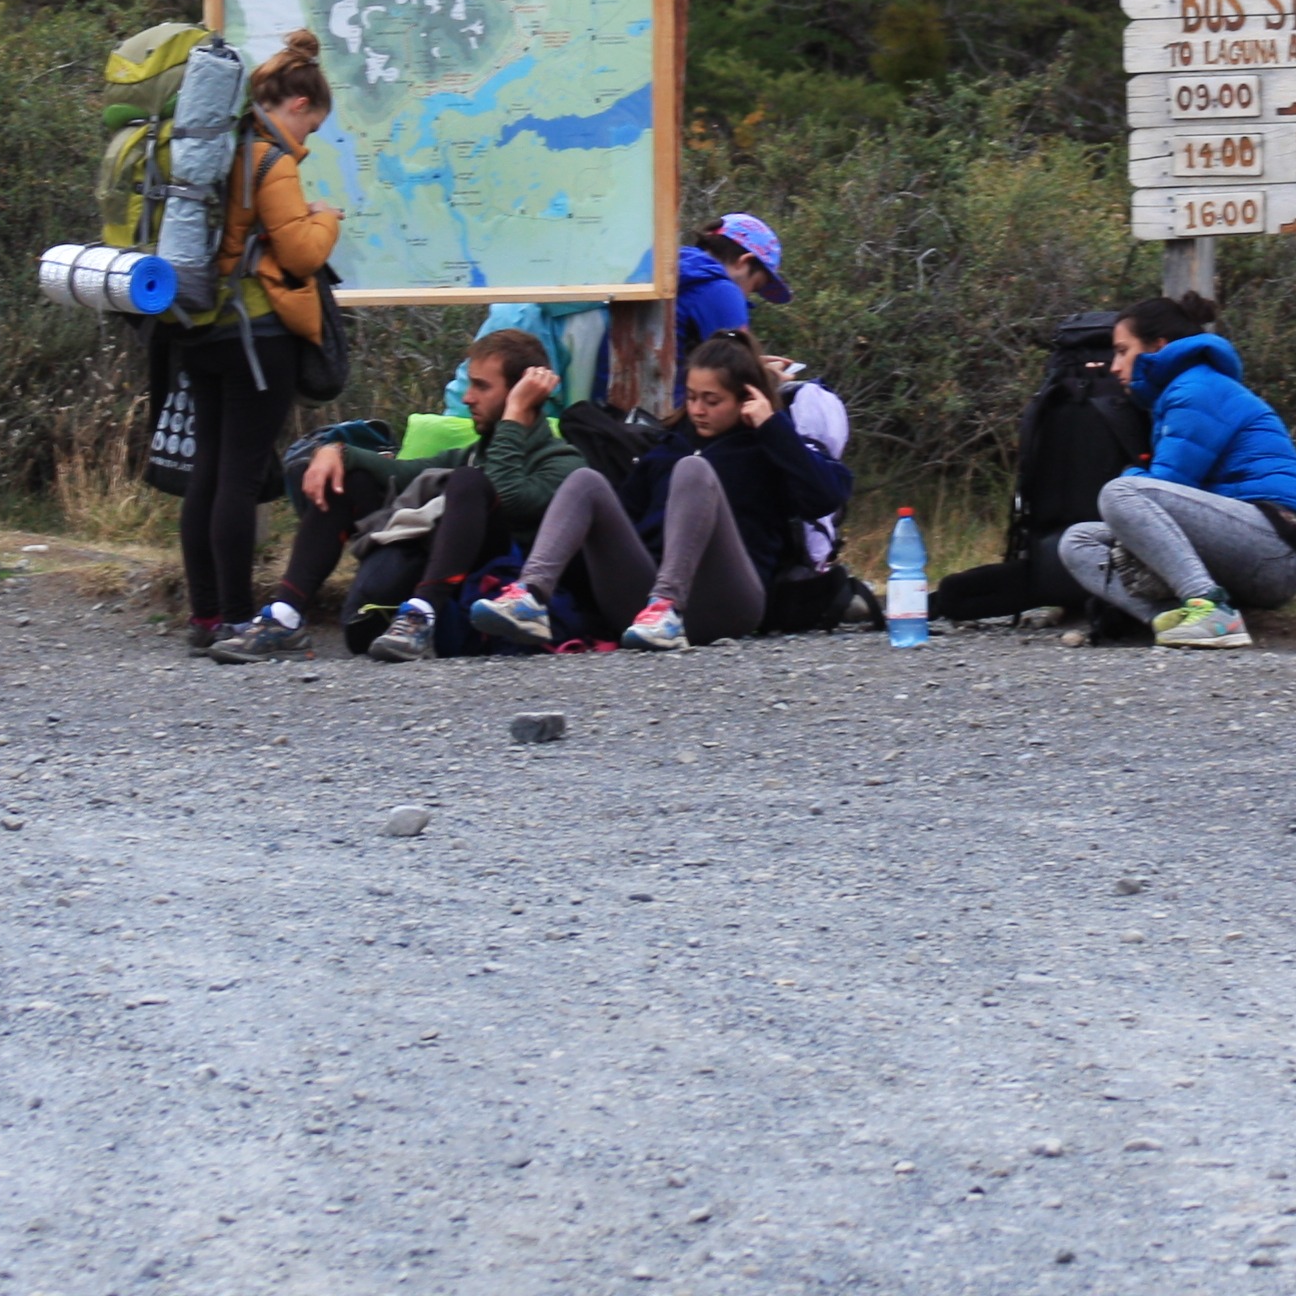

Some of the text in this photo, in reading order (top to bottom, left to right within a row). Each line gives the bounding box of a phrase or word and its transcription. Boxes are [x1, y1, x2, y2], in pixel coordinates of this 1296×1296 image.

[1166, 41, 1192, 67] TO
[1204, 39, 1278, 65] LAGUNA
[1177, 83, 1251, 111] 09:00
[1184, 199, 1257, 229] 16:00
